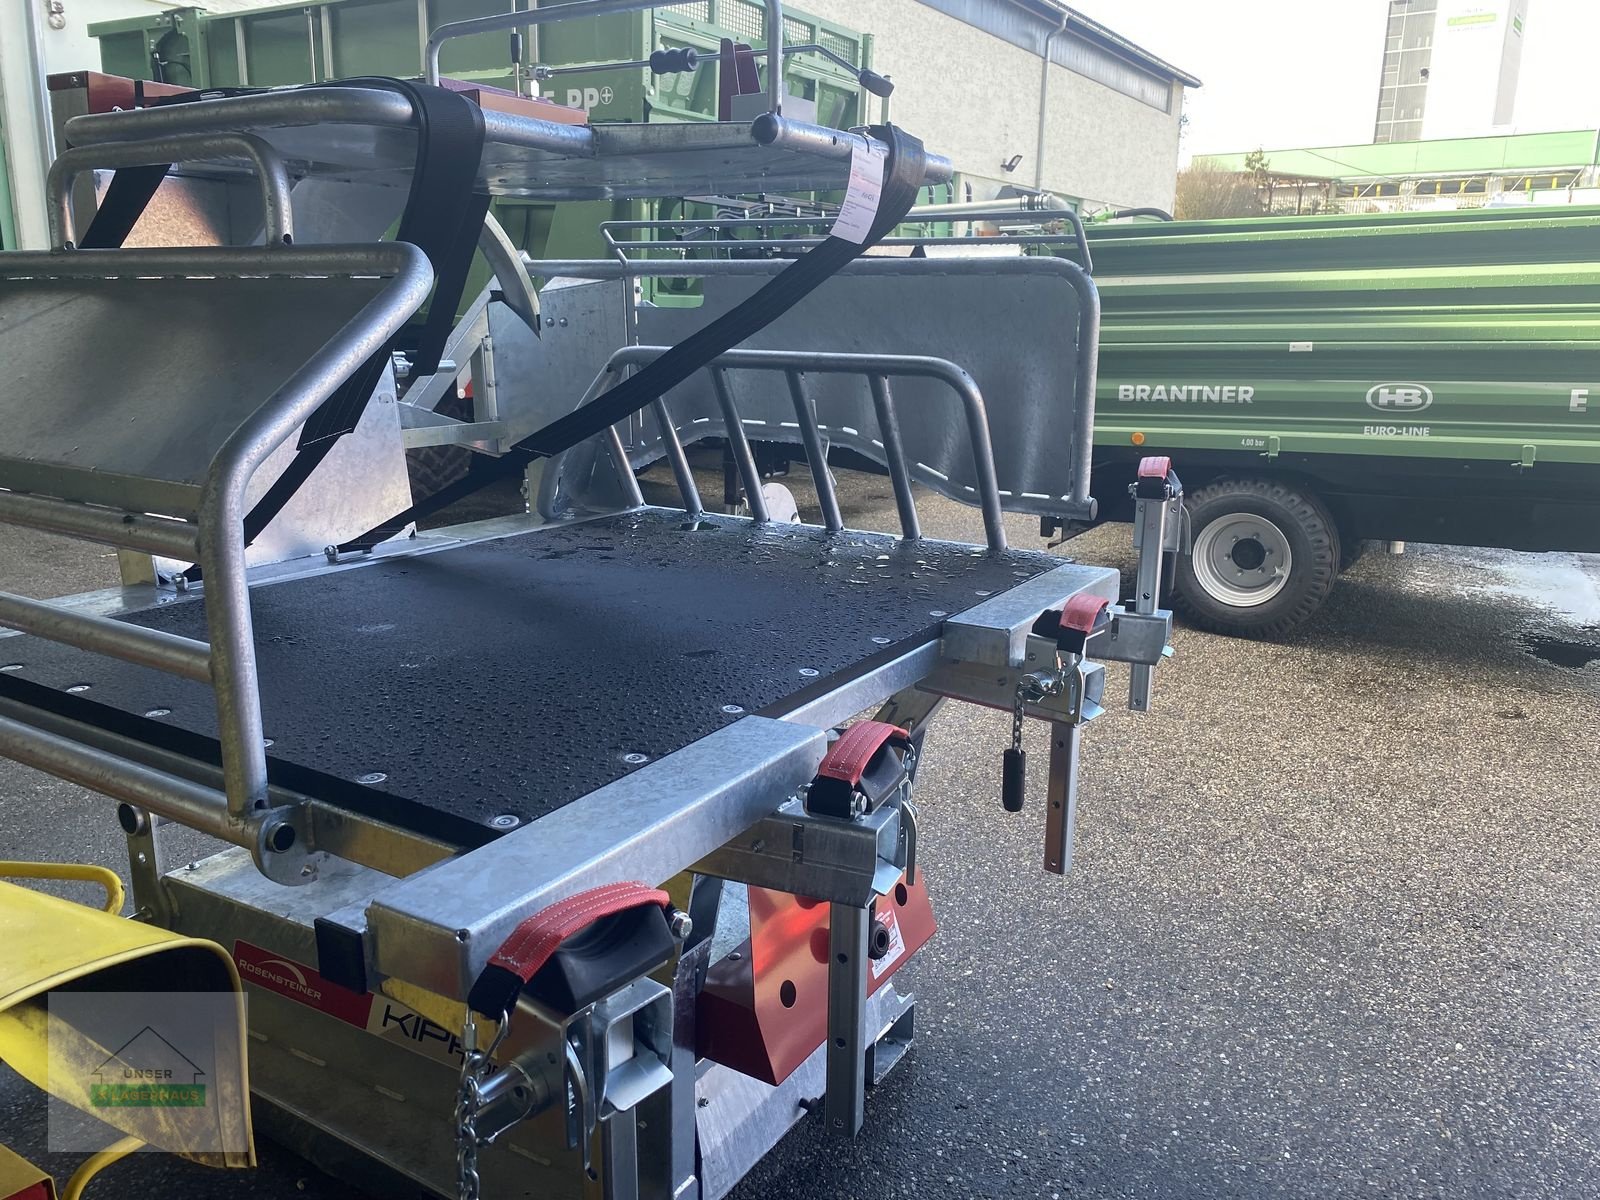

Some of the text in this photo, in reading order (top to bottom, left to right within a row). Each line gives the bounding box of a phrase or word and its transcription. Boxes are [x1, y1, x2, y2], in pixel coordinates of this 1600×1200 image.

[1118, 384, 1255, 404] BRANTNER
[1569, 388, 1589, 412] E
[1363, 425, 1430, 437] EURO-LINE
[1241, 438, 1265, 447] 4,00 bar
[238, 958, 322, 1001] ROSENSTEINER
